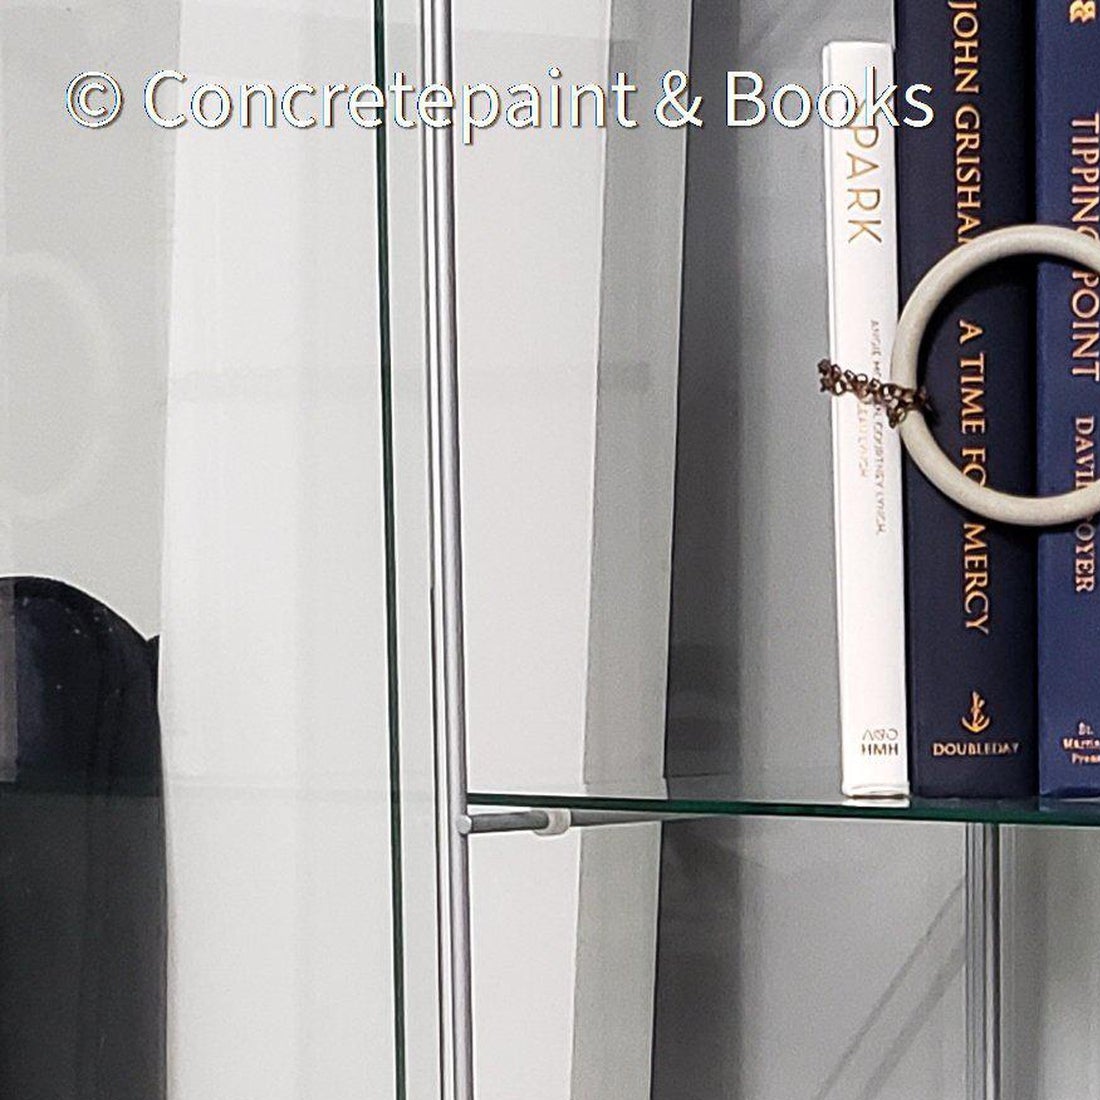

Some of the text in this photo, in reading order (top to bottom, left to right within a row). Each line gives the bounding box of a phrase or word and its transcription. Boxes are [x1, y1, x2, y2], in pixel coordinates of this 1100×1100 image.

[846, 98, 882, 244] PARK
[948, 1, 982, 245] JOHN GRISHA
[1071, 270, 1100, 382] POINT
[959, 319, 989, 635] A TIME FO MERCY
[1075, 516, 1097, 592] OYER
[861, 743, 899, 756] HMH
[933, 742, 1019, 757] DOUBLEDAY
